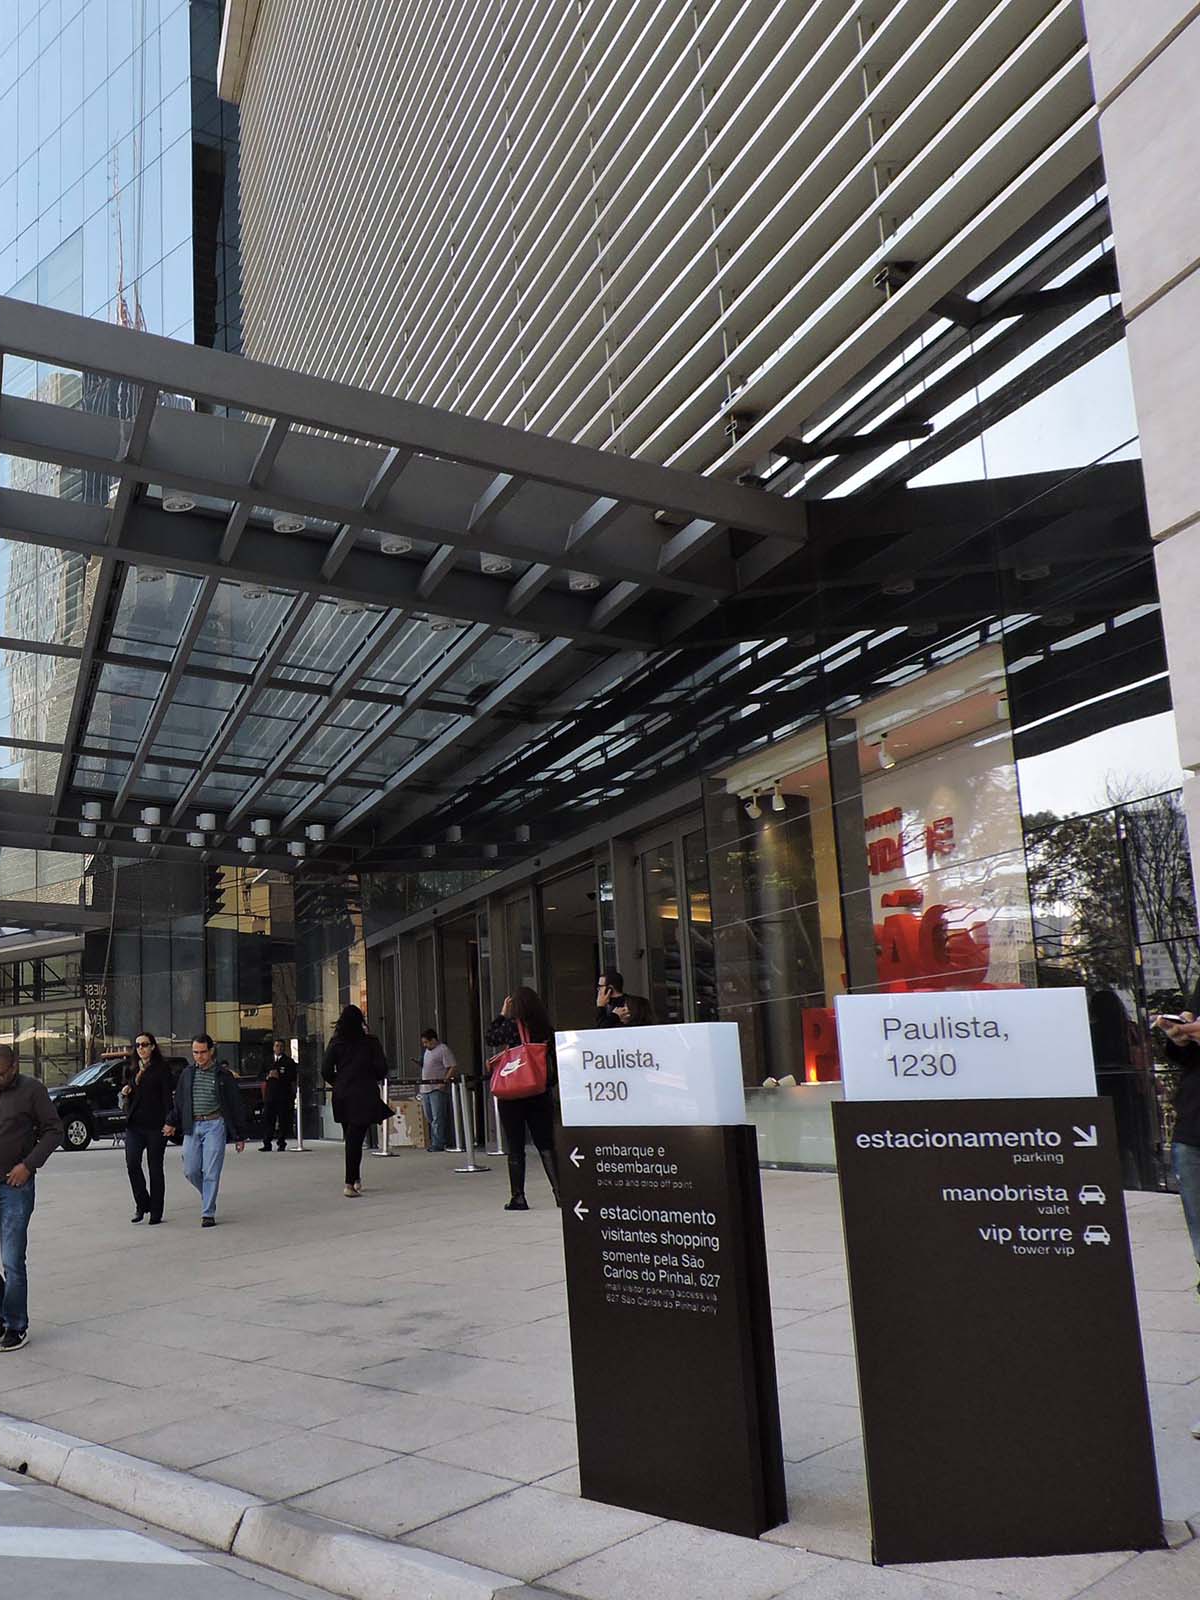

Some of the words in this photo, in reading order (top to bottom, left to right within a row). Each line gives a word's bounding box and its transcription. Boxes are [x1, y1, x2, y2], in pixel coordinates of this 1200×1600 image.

[883, 1016, 1009, 1042] Paulista,
[582, 1049, 660, 1071] Paulista,
[887, 1053, 957, 1077] 1230
[585, 1081, 628, 1101] 1230
[856, 1128, 1062, 1149] estacionamento
[595, 1144, 654, 1159] embarque
[658, 1147, 665, 1157] e
[1013, 1152, 1064, 1164] parking
[596, 1160, 678, 1176] desembarque
[942, 1184, 1069, 1201] manobrista
[600, 1205, 716, 1225] estacionamento
[1037, 1204, 1071, 1215] valet
[601, 1227, 658, 1243] visitantes
[660, 1231, 720, 1252] shopping
[979, 1225, 1012, 1246] vip
[1018, 1225, 1073, 1241] torre
[602, 1250, 651, 1264] somente
[653, 1253, 679, 1267] pela
[681, 1254, 705, 1269] São
[1013, 1245, 1050, 1256] tower
[1055, 1244, 1075, 1257] vip
[603, 1264, 639, 1280] Carlos
[641, 1269, 656, 1282] do
[659, 1269, 697, 1286] Pinhal,
[700, 1273, 720, 1288] 627
